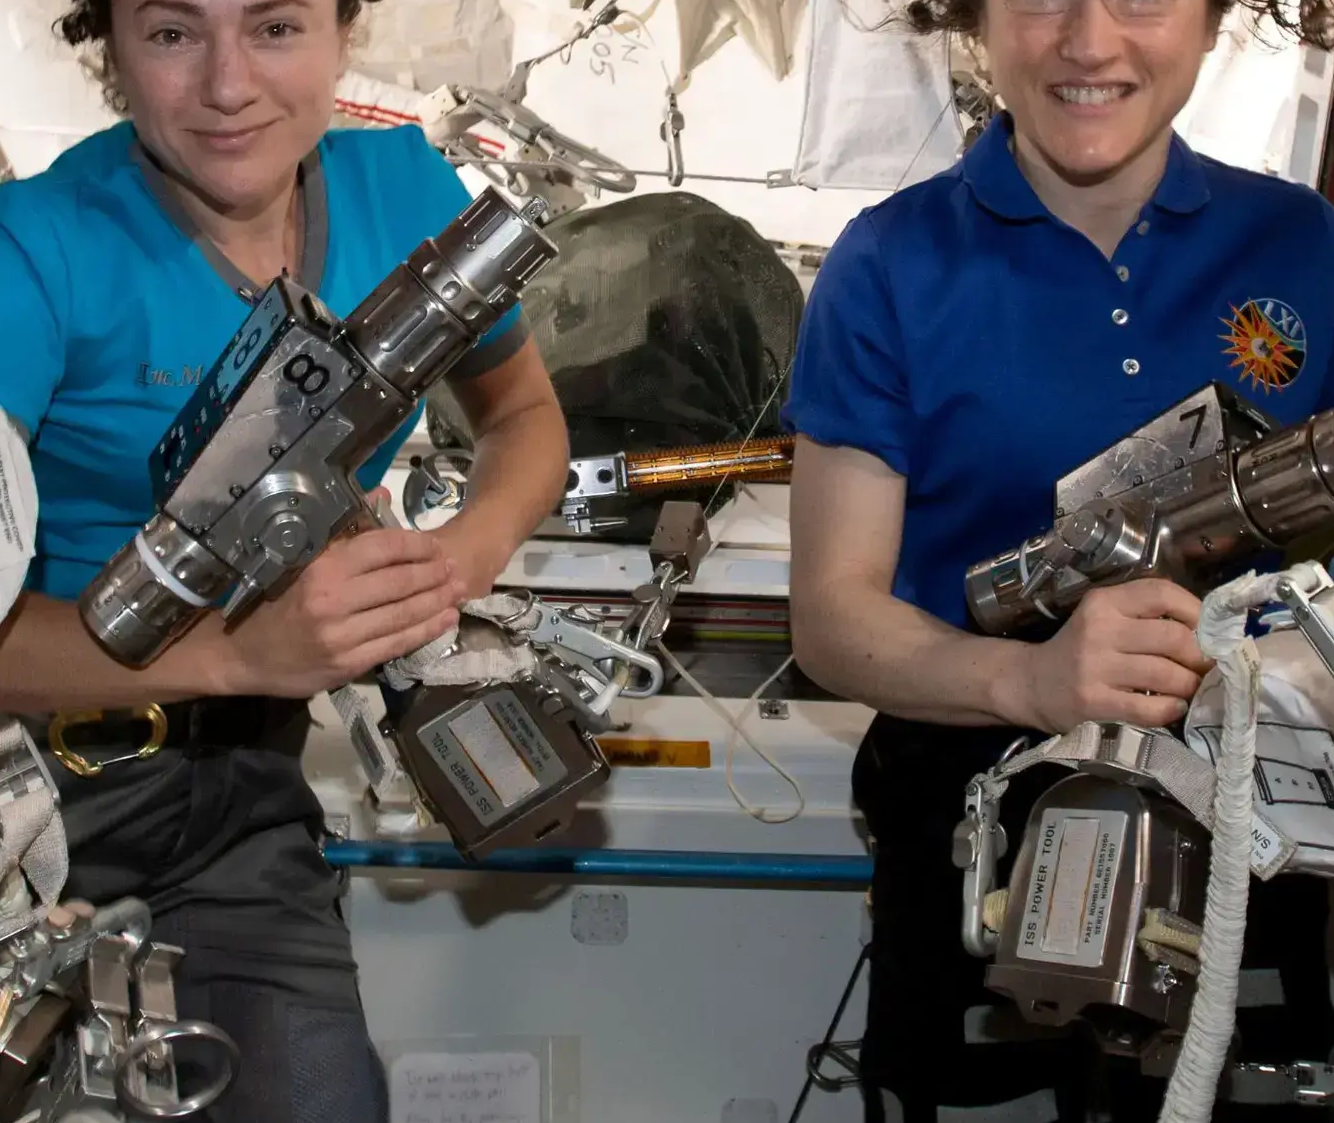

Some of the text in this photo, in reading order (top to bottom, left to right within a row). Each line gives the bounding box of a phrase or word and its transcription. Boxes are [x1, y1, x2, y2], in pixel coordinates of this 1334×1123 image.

[1264, 301, 1301, 338] LXI
[233, 326, 261, 370] 8
[282, 353, 331, 396] 8
[1179, 404, 1207, 449] 7
[431, 733, 494, 815] ISS POWER TOOL
[1251, 828, 1271, 849] S/N
[1025, 821, 1057, 946] ISS POWER TOOL
[1095, 906, 1105, 935] SERIAL
[1101, 866, 1112, 899] NUMBER
[1085, 921, 1093, 944] PART
[1091, 883, 1100, 917] NUMBER
